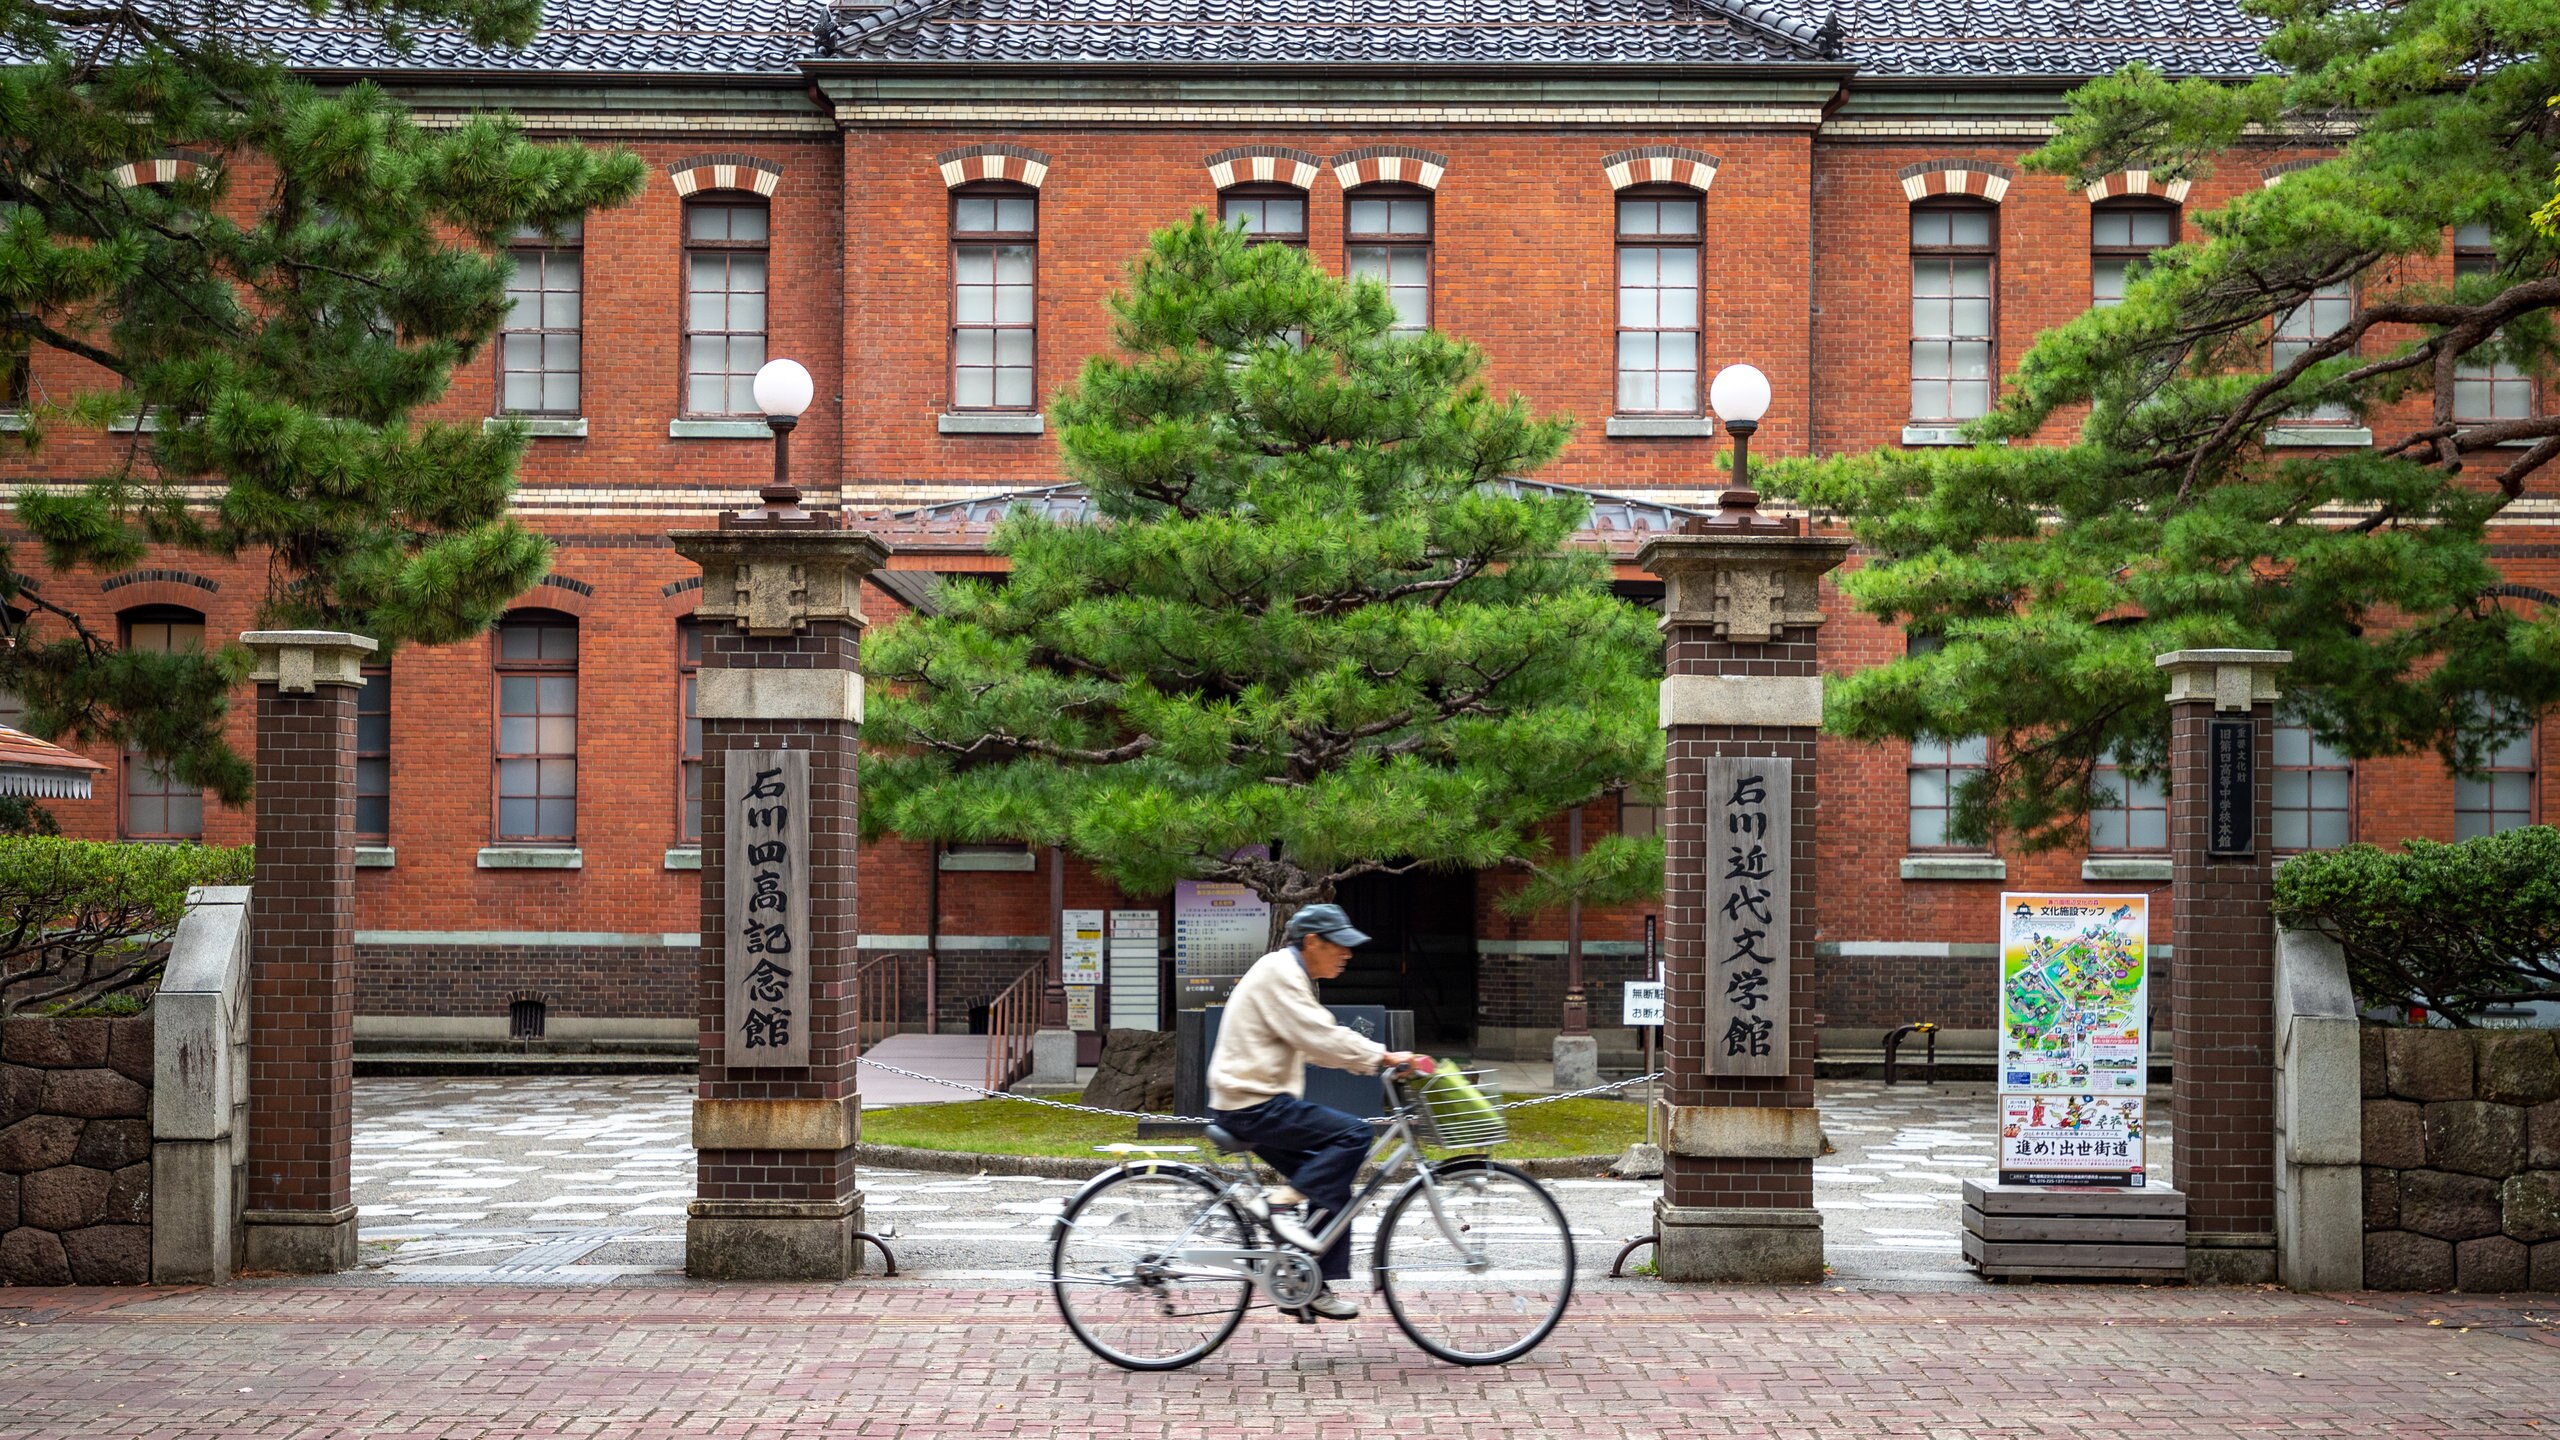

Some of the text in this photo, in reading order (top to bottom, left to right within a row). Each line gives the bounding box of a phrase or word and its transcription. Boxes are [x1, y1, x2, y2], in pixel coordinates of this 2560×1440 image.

[2235, 727, 2248, 783] 重要文化財
[2218, 728, 2233, 848] 旧第四高等中学校本館
[739, 766, 793, 1050] 石川四高記念館
[1720, 774, 1776, 1058] 石川近代文学館
[2040, 906, 2106, 917] 文化施設マップ
[1632, 1008, 1664, 1019] お断わ
[2015, 1139, 2129, 1157] 進め!出世街道
